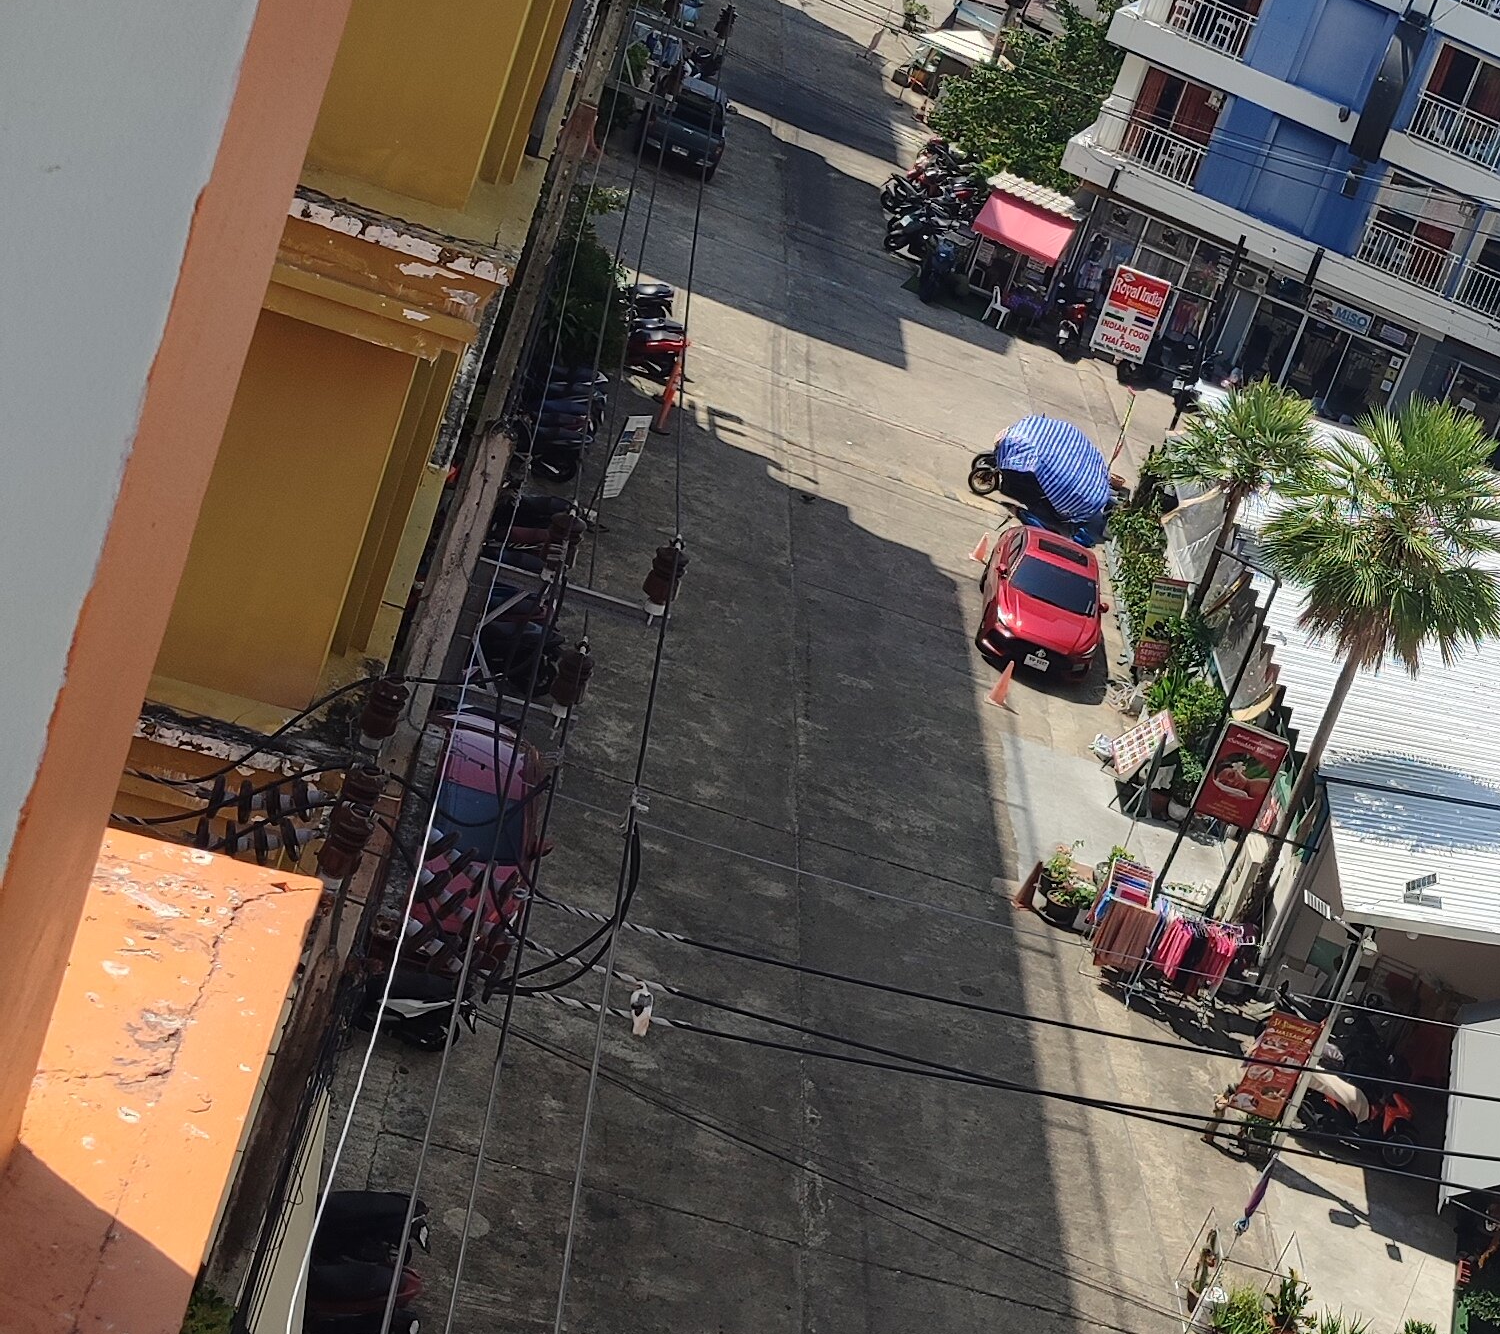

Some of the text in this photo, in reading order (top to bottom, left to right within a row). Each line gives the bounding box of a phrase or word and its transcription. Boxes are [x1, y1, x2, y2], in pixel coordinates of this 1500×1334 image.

[1113, 277, 1164, 308] Royal India
[1101, 319, 1150, 342] INDIAN FOOD
[1101, 333, 1119, 346] THAI
[1119, 341, 1141, 354] FOOD
